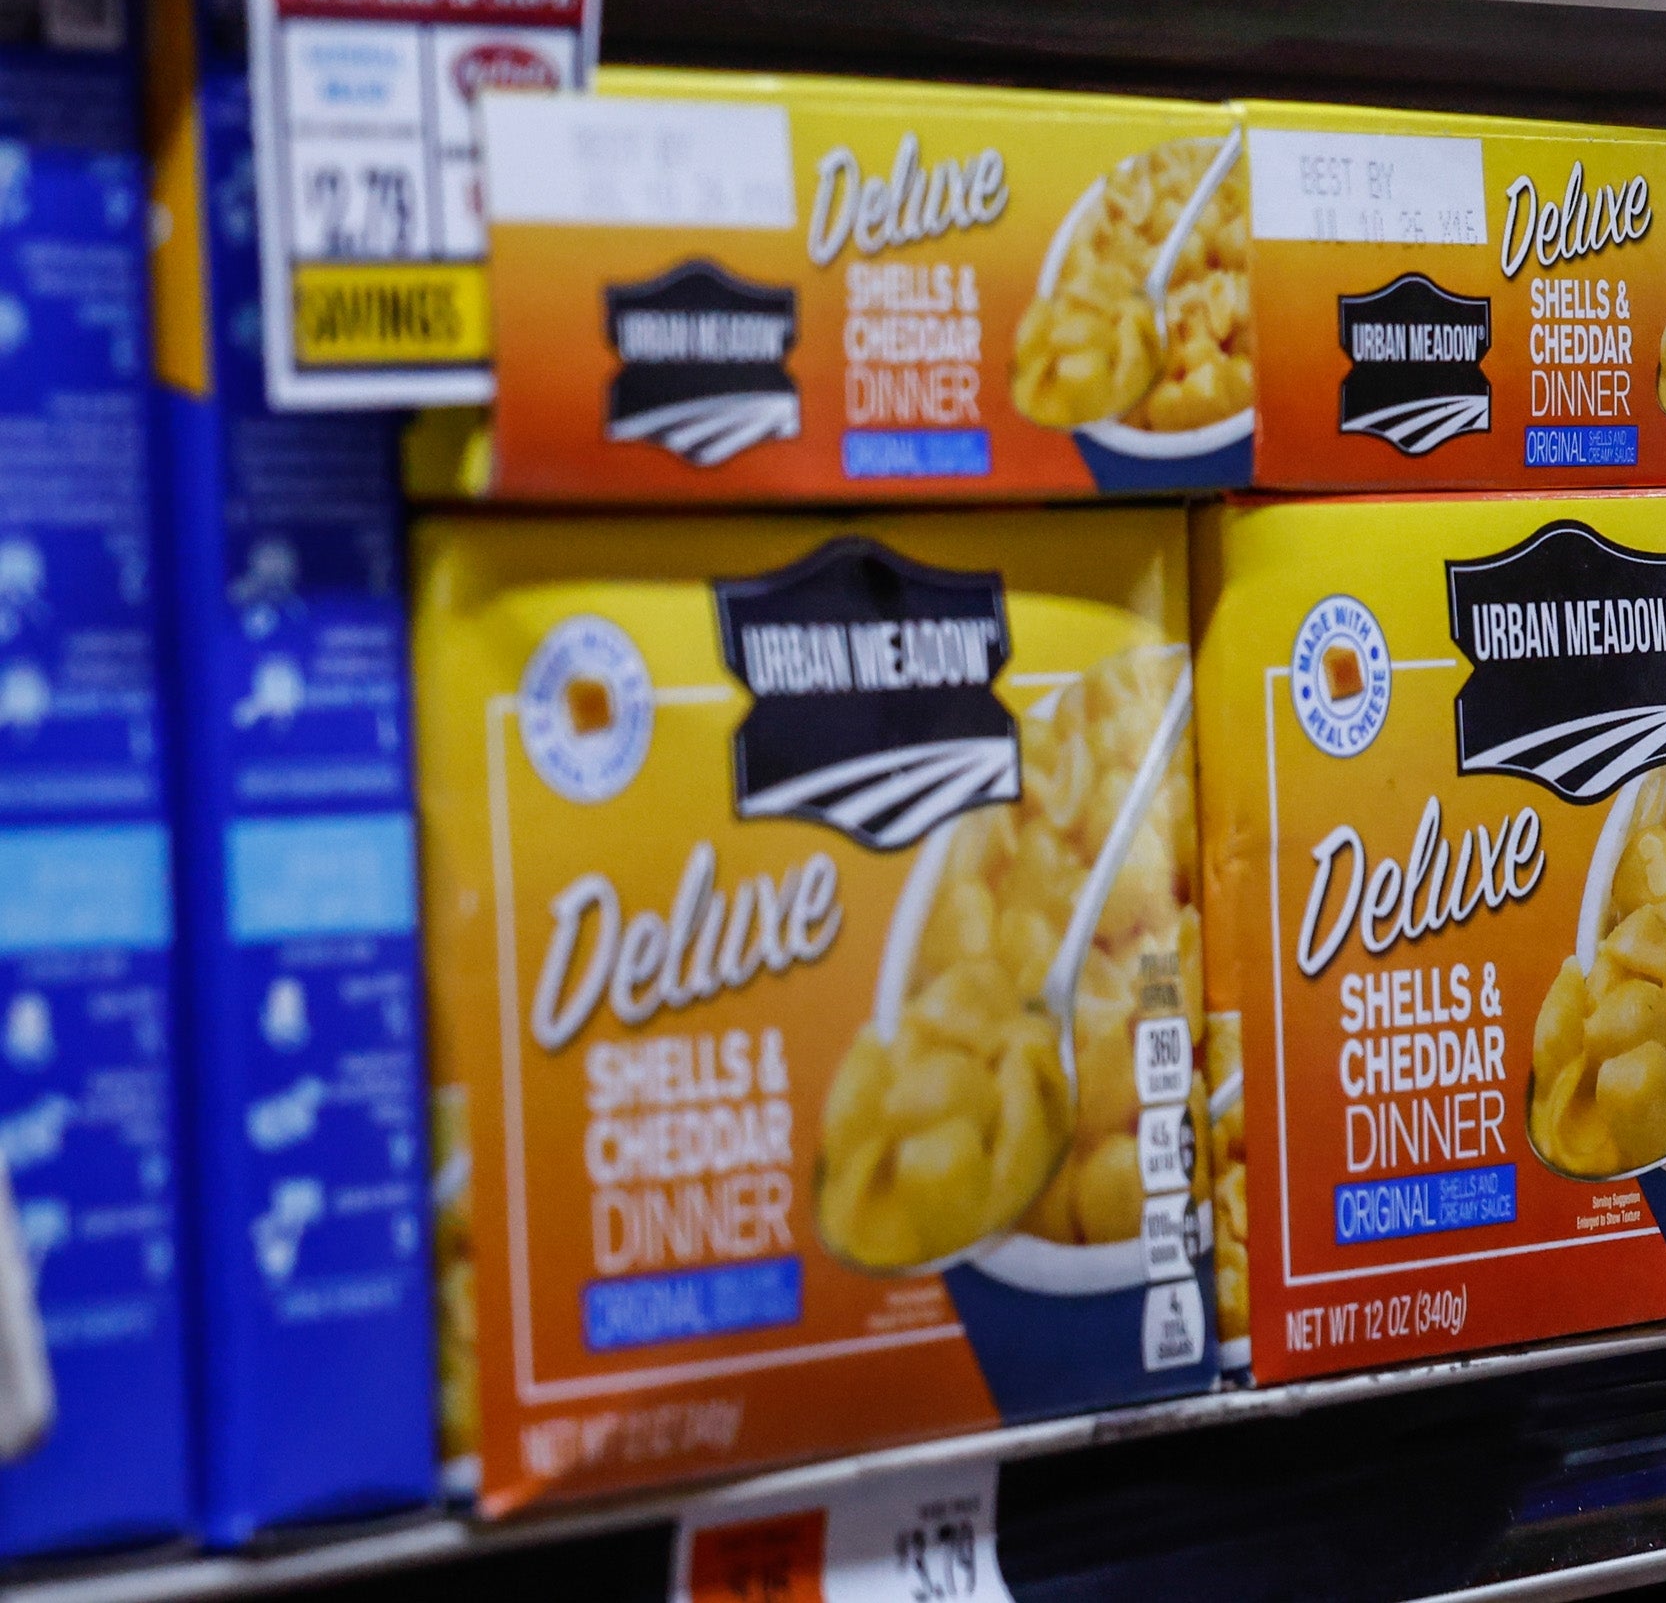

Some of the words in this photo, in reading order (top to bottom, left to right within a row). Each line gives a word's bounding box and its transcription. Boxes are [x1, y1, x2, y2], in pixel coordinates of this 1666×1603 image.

[807, 132, 1008, 266] Deluxe
[1301, 155, 1352, 196] BEST
[1368, 161, 1394, 199] BY
[1501, 160, 1652, 277] Deluxe
[845, 262, 954, 312] SHELLS
[1530, 277, 1610, 320] SHELLS
[1615, 279, 1630, 320] &
[1351, 322, 1406, 362] URBAN
[1529, 323, 1632, 365] CHEDDAR
[843, 364, 981, 424] DINNER
[1530, 369, 1631, 417] DINNER
[1526, 430, 1587, 464] ORIGINAL
[741, 622, 850, 696] URBAN
[1299, 612, 1331, 673] MADE
[1335, 605, 1371, 641] WITH
[1472, 600, 1560, 662] URBAN
[1308, 706, 1343, 748] REAL
[1349, 670, 1386, 745] CHEESE
[1296, 794, 1545, 977] Deluxe
[531, 840, 843, 1052] Deluxe
[1340, 962, 1472, 1034] SHELLS
[1480, 960, 1503, 1018] &
[585, 1031, 752, 1115] SHELLS
[757, 1025, 789, 1094] &
[1149, 1028, 1180, 1067] 360
[1339, 1025, 1507, 1098] CHEDDAR
[584, 1098, 793, 1186] CHEDDAR
[1344, 1090, 1507, 1174] DINNER
[591, 1170, 794, 1275] DINNER
[1337, 1185, 1437, 1239] ORIGINAL
[1286, 1307, 1326, 1352] NET
[1329, 1302, 1359, 1345] WT
[1364, 1298, 1383, 1340] 12
[1387, 1295, 1411, 1337] OZ
[1415, 1283, 1468, 1337] (340g)
